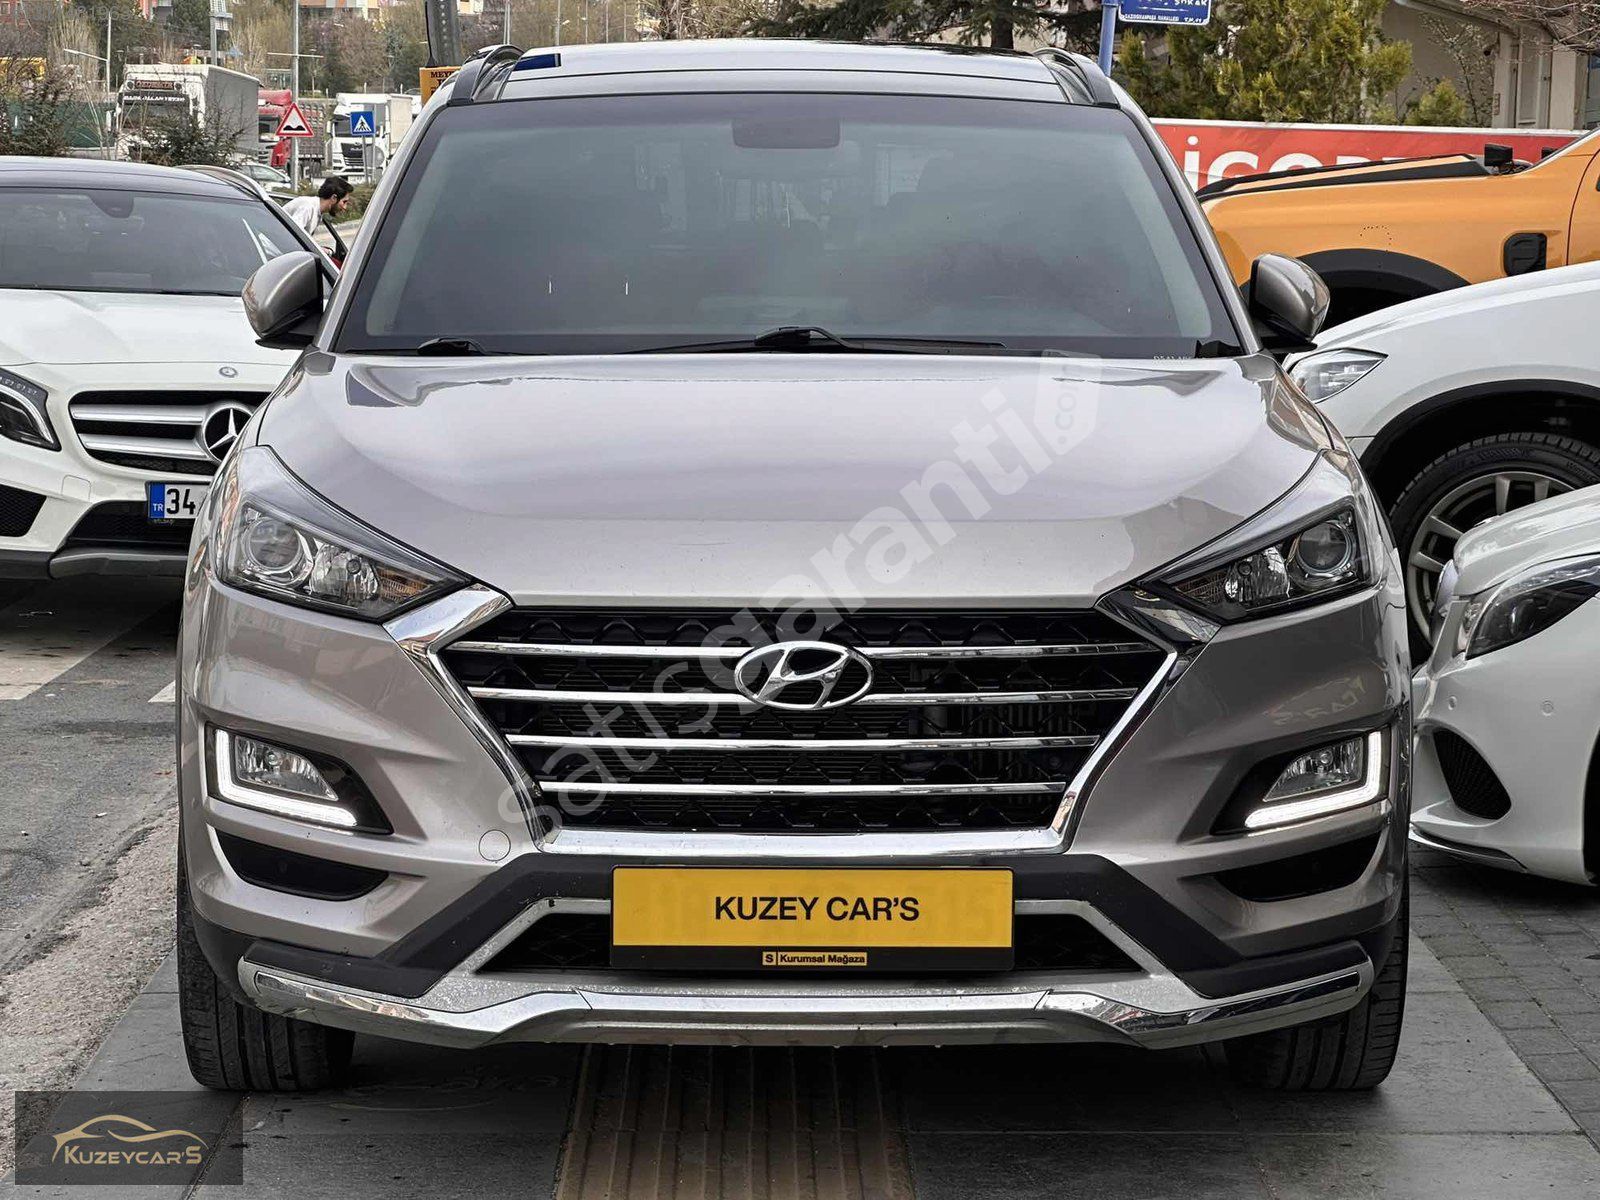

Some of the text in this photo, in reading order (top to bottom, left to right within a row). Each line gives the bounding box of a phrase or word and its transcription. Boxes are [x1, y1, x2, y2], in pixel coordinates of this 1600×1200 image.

[152, 503, 164, 512] TR
[166, 488, 196, 515] 34
[715, 896, 920, 922] KUZEY CAR'S
[764, 953, 865, 966] S Kurumsal Mağaza
